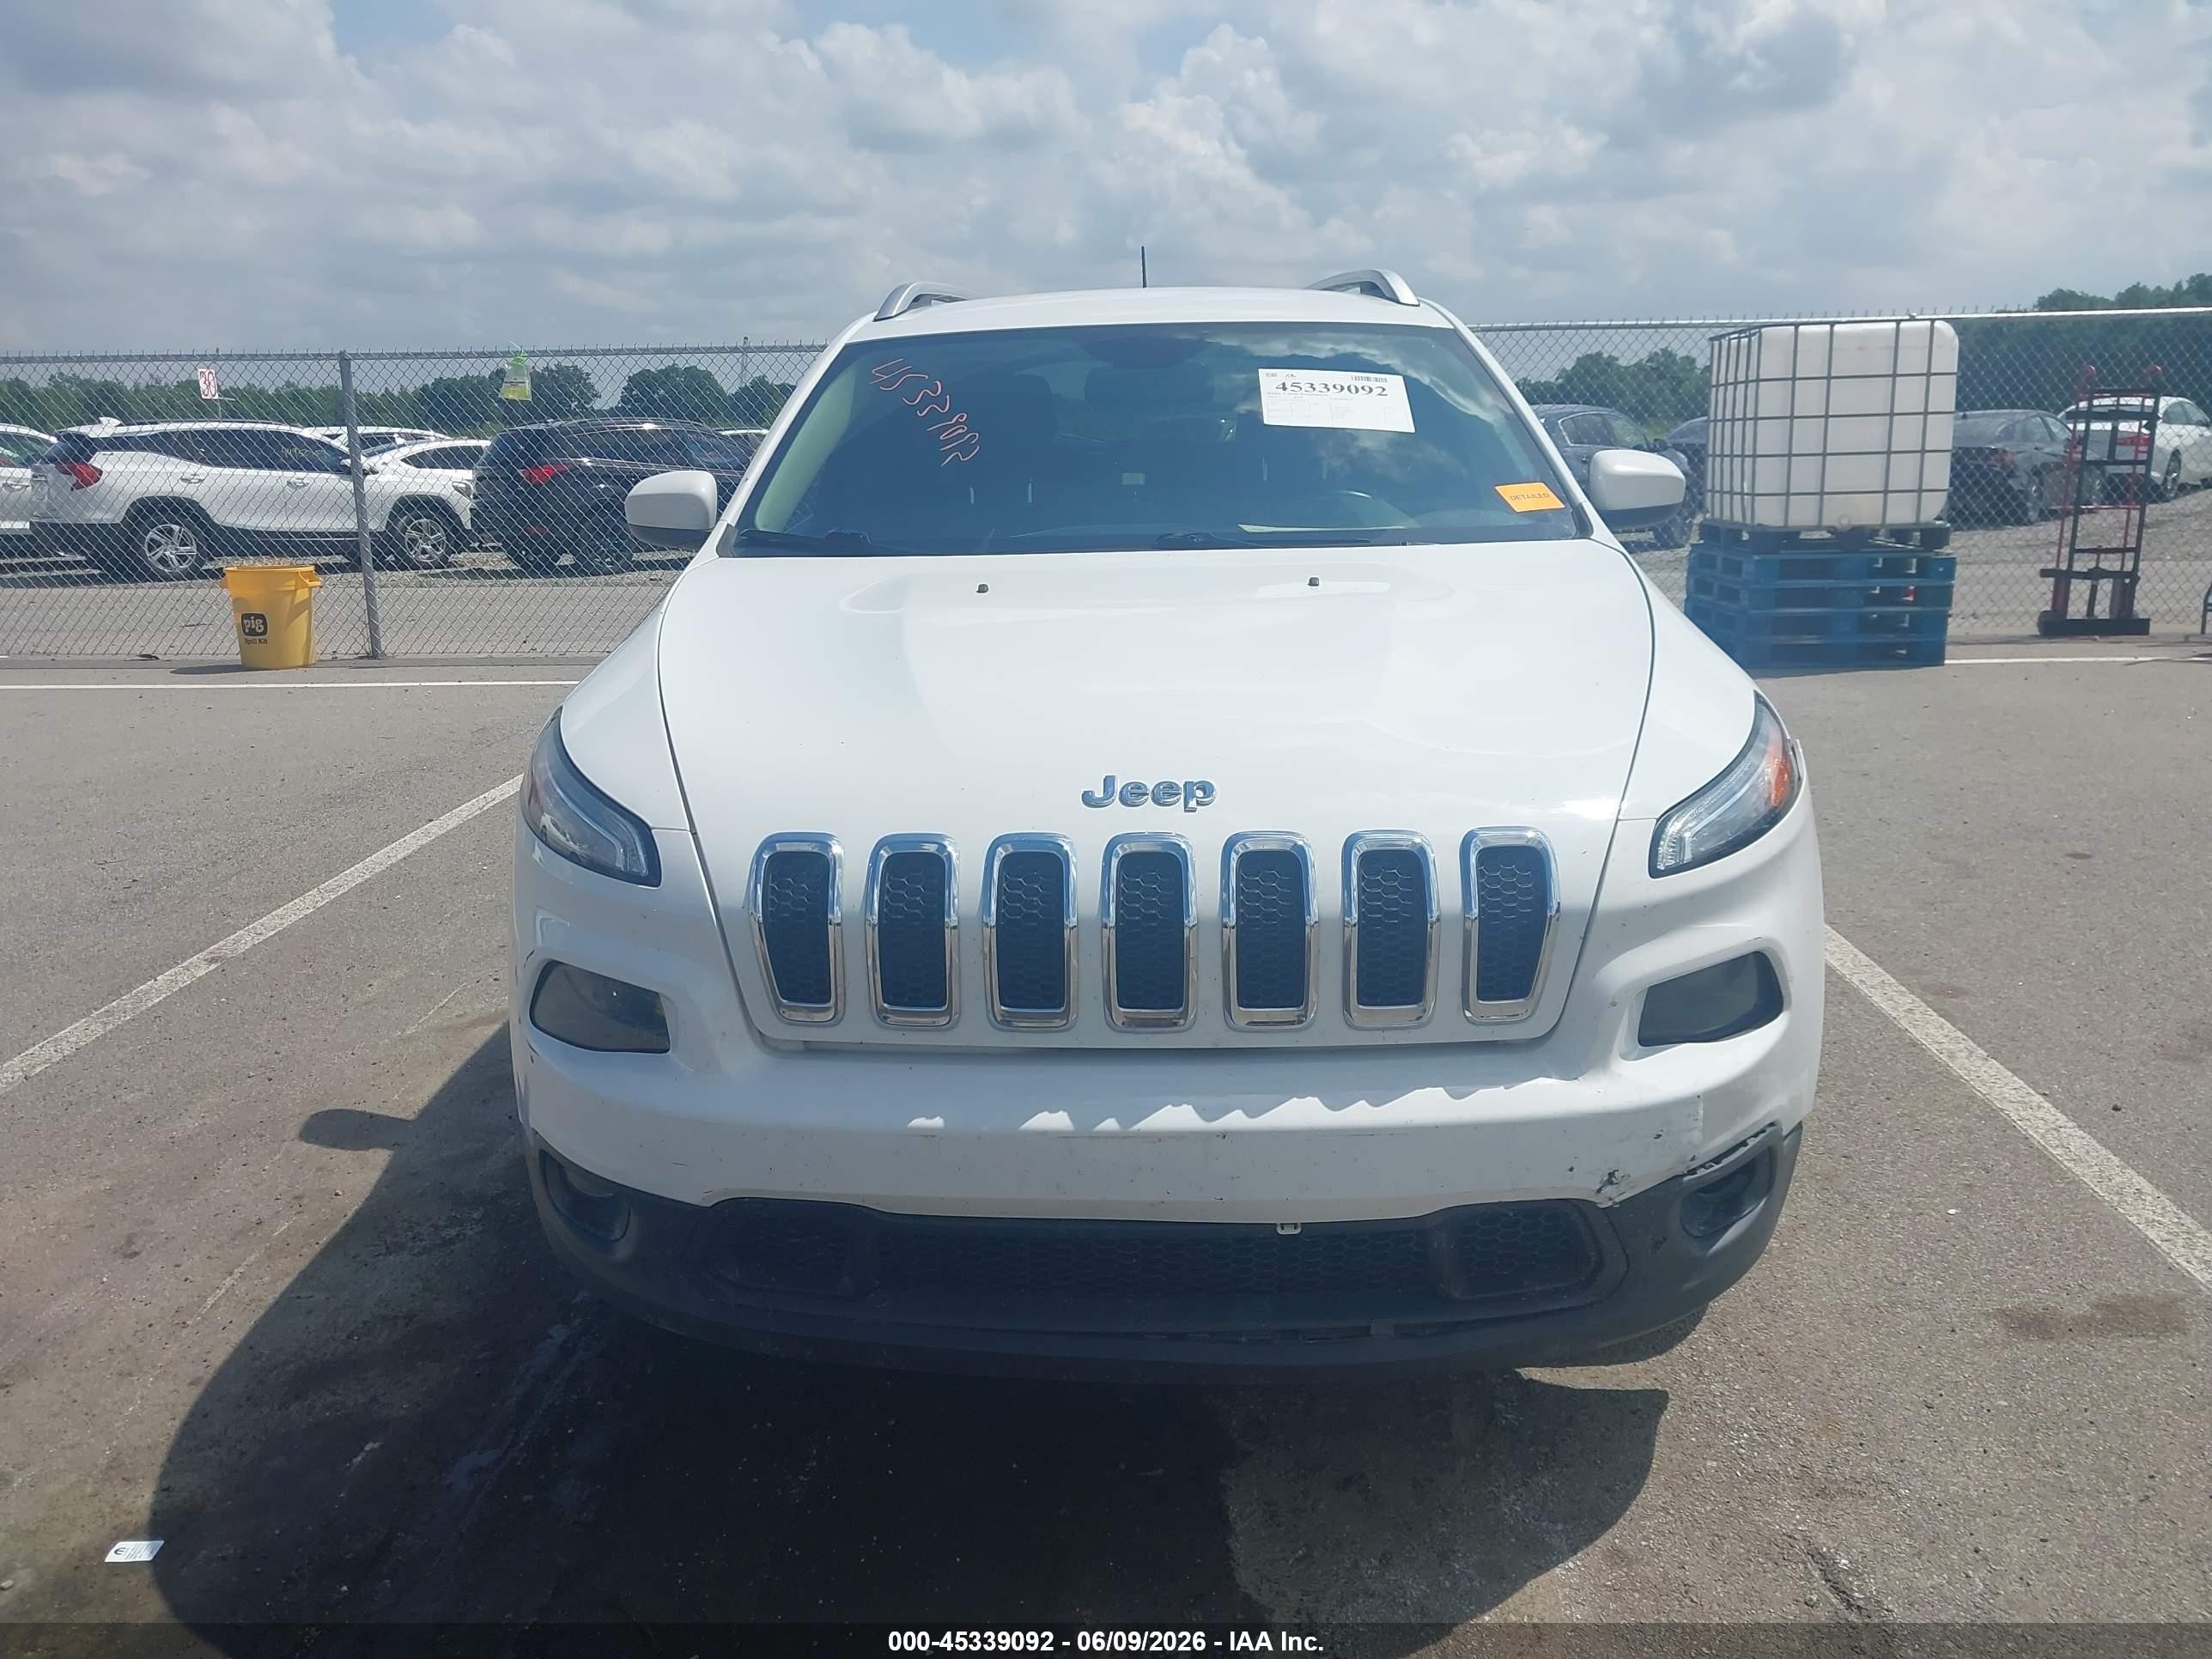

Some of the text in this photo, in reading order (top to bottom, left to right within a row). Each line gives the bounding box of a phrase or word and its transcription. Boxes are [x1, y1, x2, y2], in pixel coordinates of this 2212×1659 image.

[199, 370, 216, 397] 30
[1275, 381, 1389, 397] 45339092
[869, 358, 980, 466] 45339092
[244, 616, 264, 633] pig
[1081, 775, 1216, 812] Jeep
